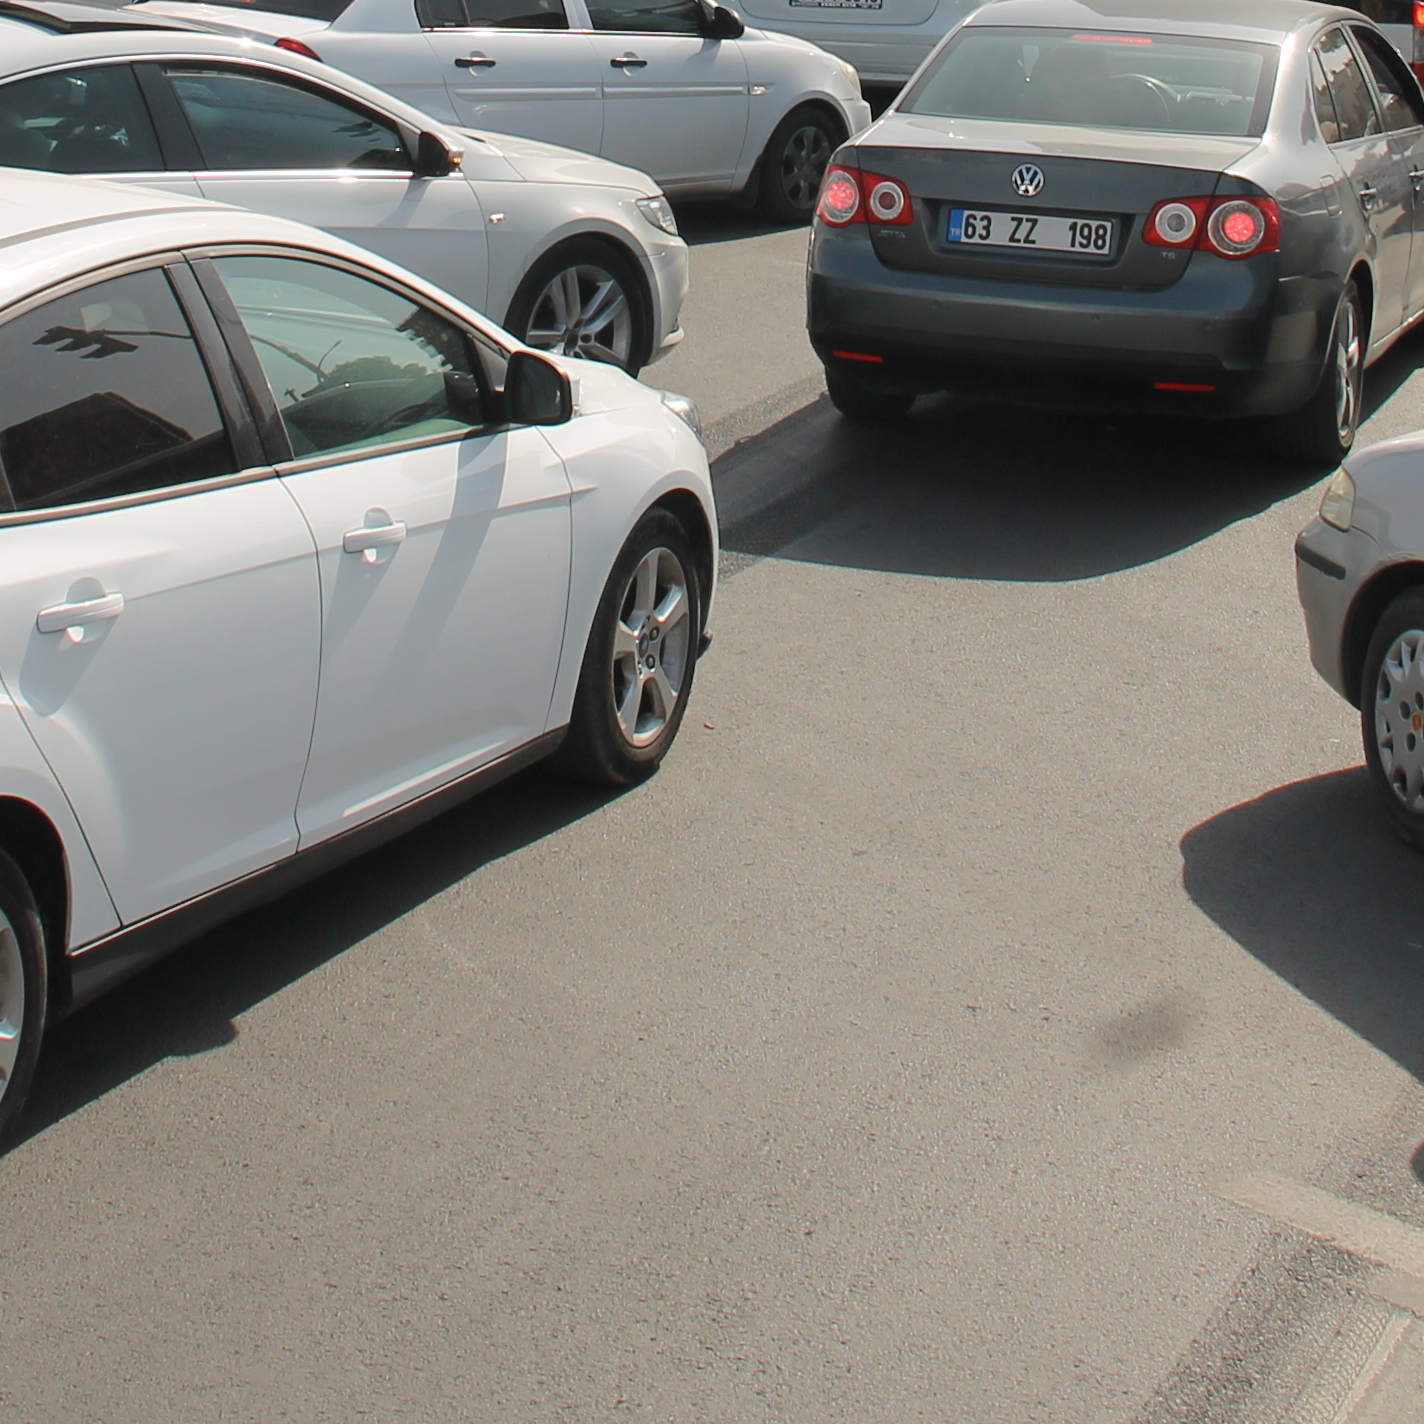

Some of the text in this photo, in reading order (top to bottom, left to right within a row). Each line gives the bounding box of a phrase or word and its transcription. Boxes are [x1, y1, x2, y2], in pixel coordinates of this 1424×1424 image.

[963, 214, 1108, 251] 63 ZZ 198
